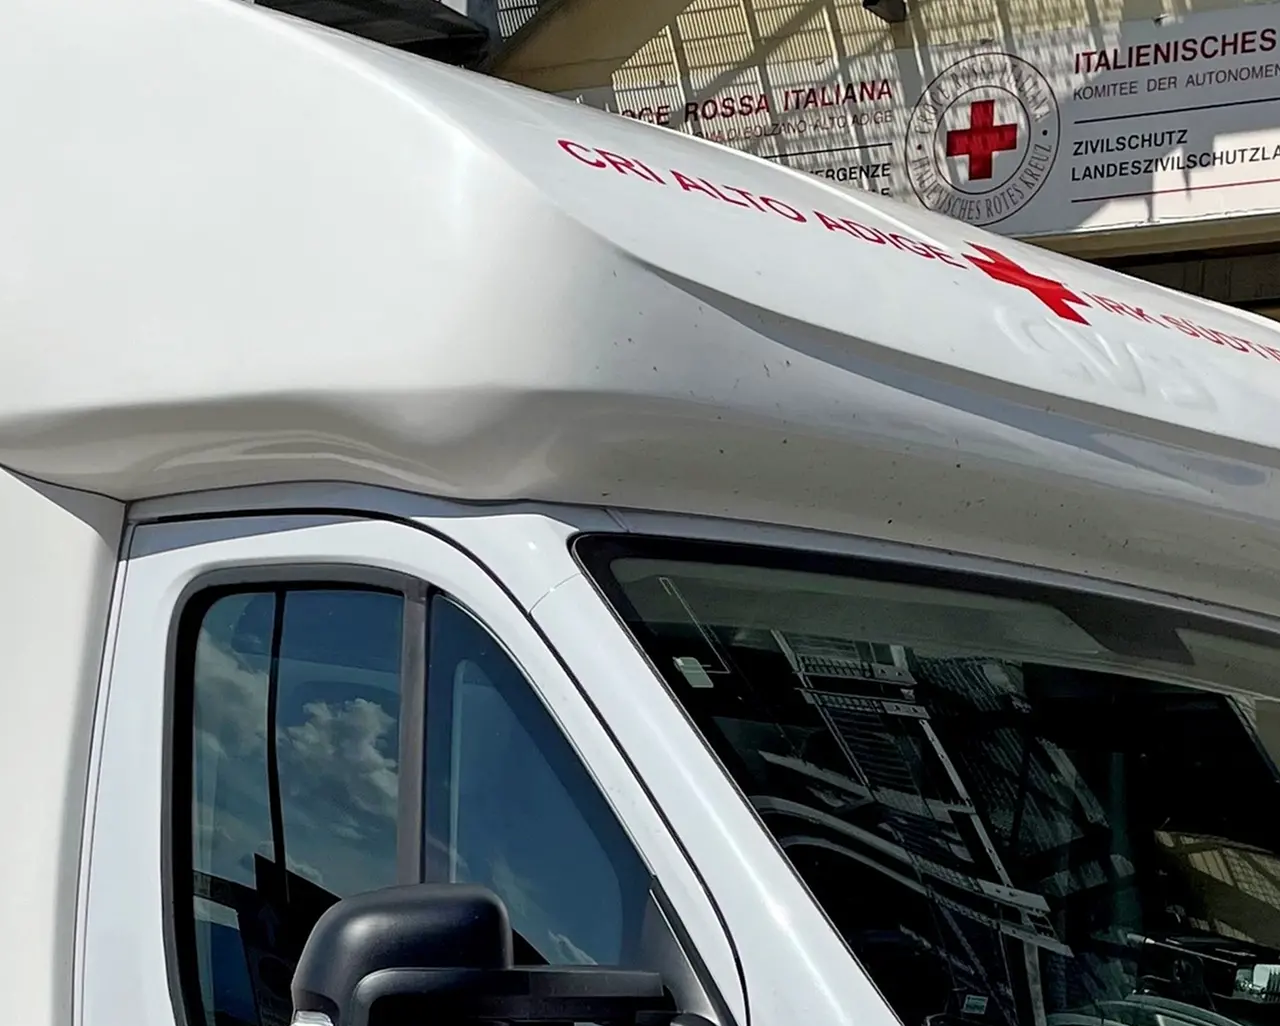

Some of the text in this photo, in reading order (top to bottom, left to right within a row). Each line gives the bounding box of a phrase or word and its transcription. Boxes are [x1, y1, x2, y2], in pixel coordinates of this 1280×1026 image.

[1074, 28, 1277, 74] ITALIENISCHES
[683, 94, 771, 123] ROSSA
[783, 78, 894, 112] ITALIANA
[1073, 81, 1138, 101] KOMITEE
[1146, 76, 1177, 93] DER
[852, 108, 893, 126] ADIGE
[1072, 129, 1188, 156] ZIVILSCHUTZ
[985, 183, 1025, 219] ROTES
[1020, 143, 1052, 190] KREUZ
[556, 138, 666, 185] CRI
[669, 169, 807, 223] ALTO
[813, 210, 969, 270] ADIGE
[1081, 291, 1170, 329] IRK
